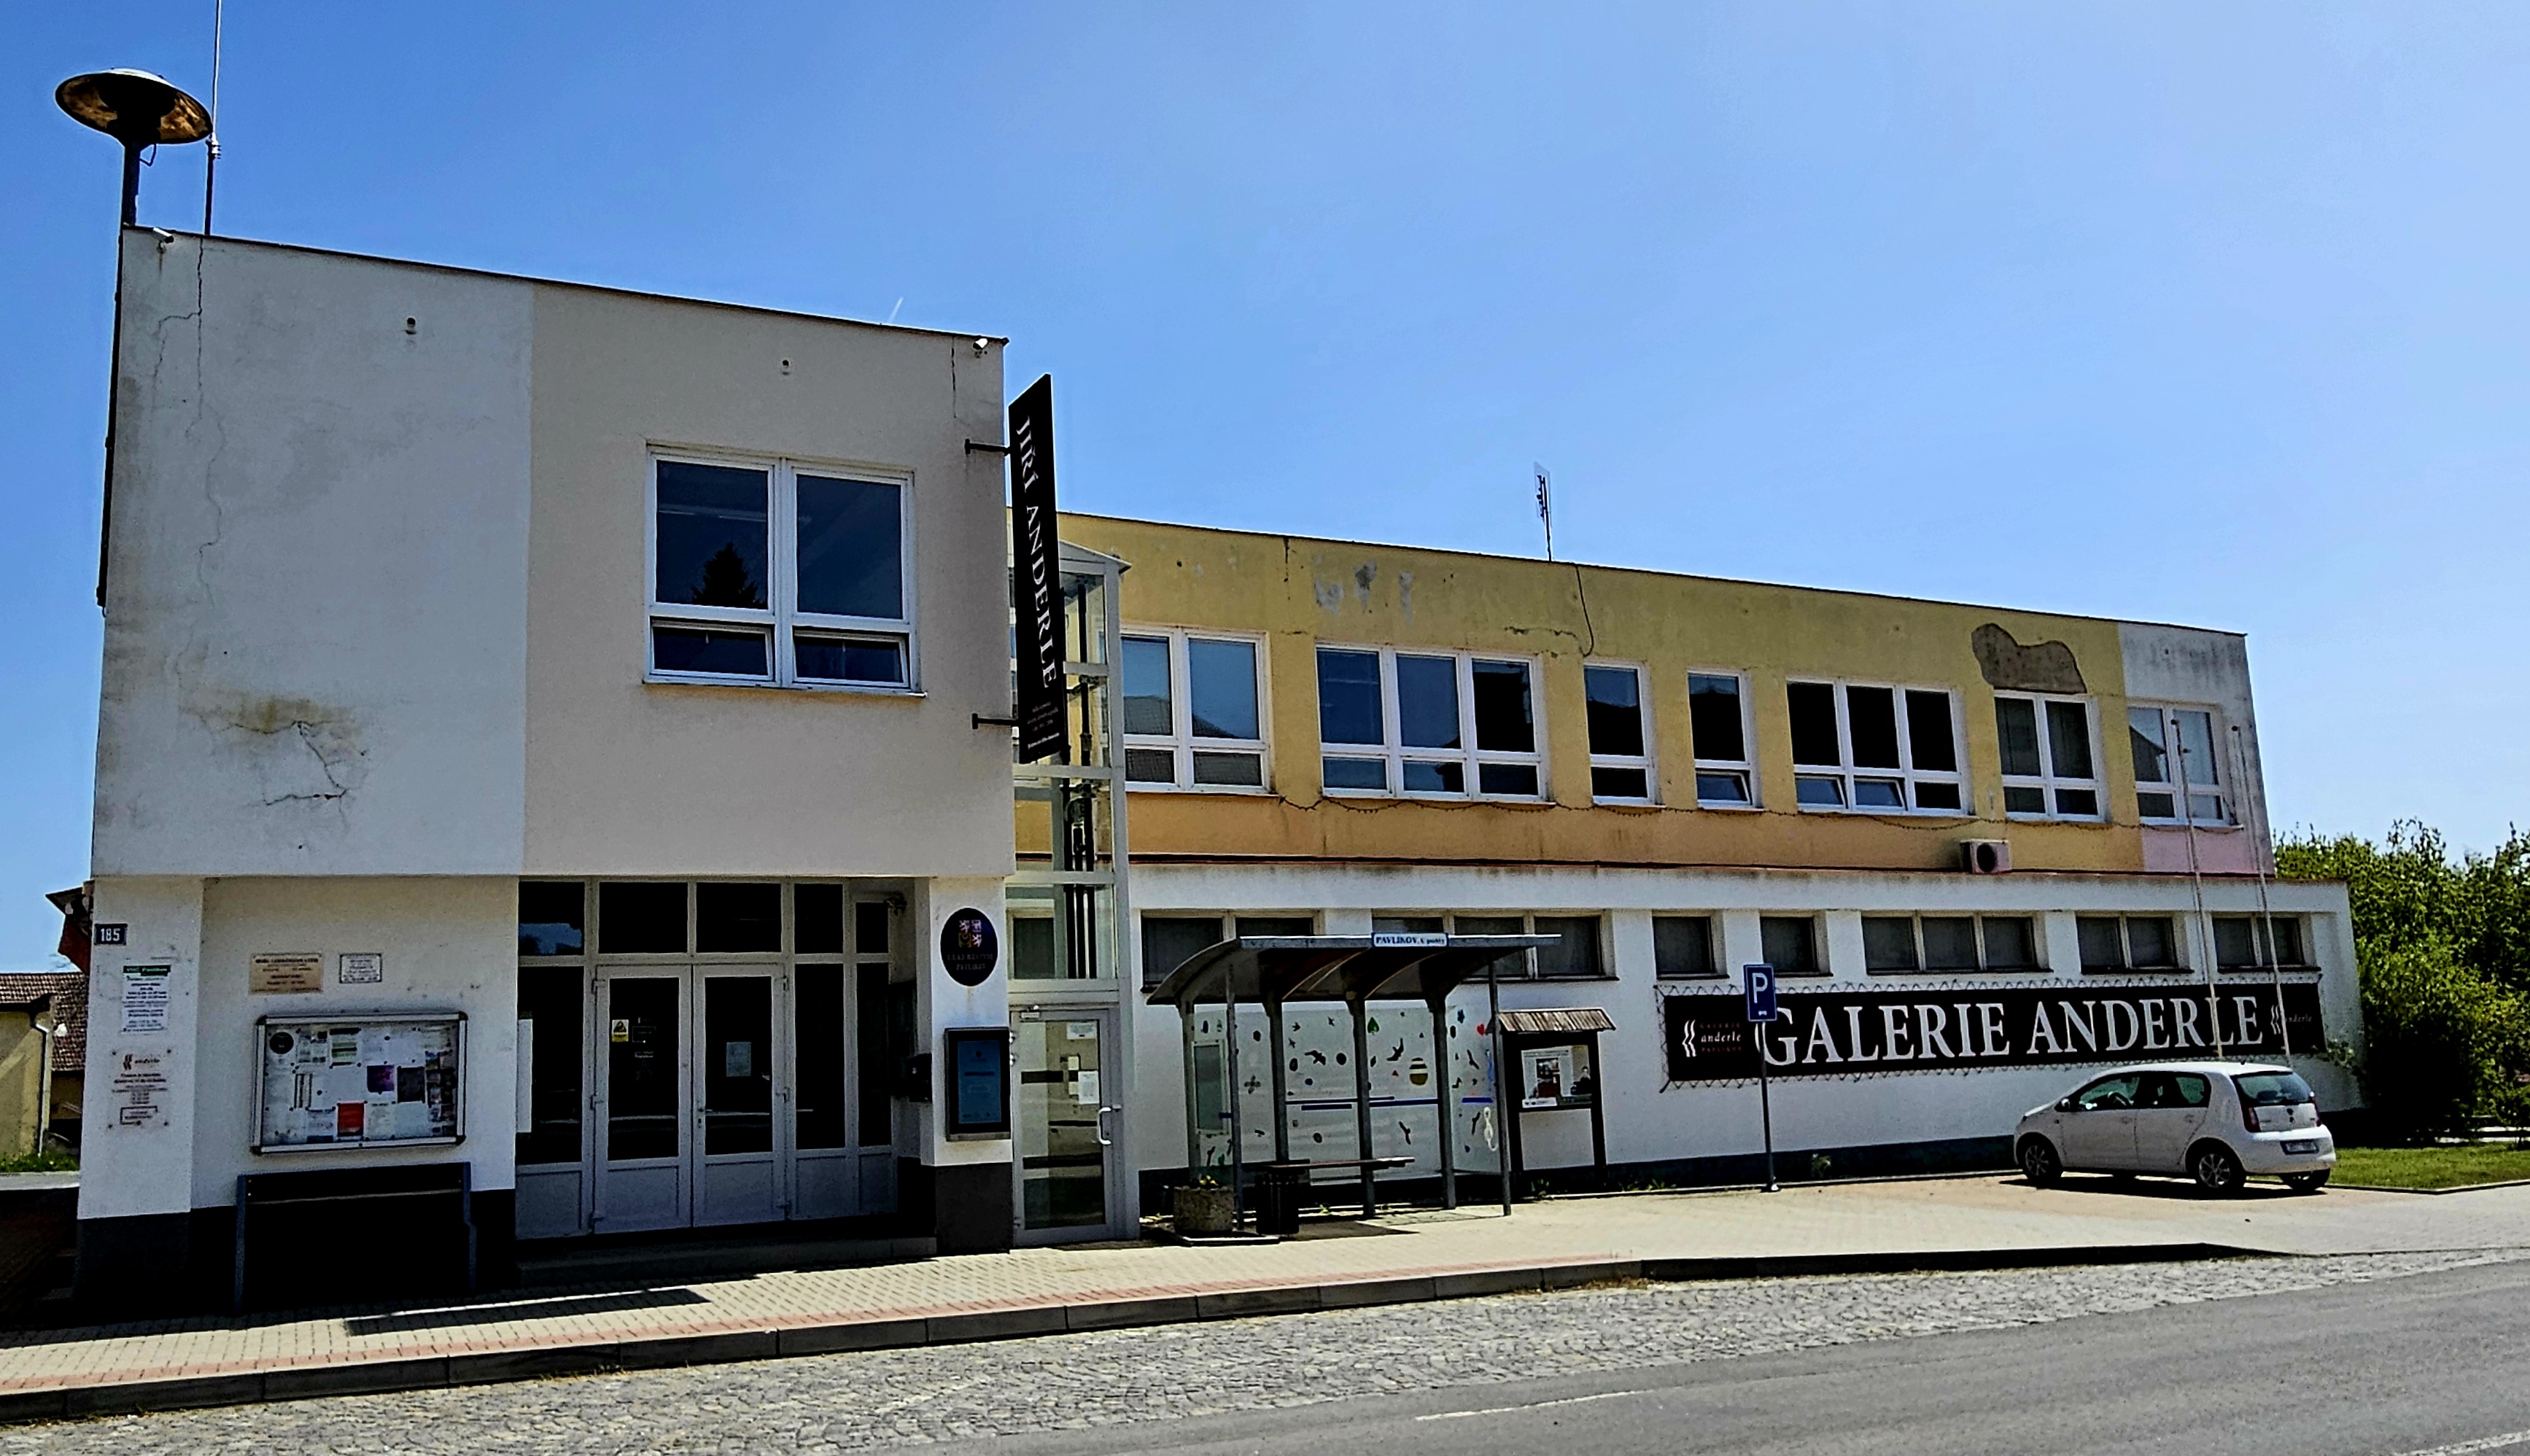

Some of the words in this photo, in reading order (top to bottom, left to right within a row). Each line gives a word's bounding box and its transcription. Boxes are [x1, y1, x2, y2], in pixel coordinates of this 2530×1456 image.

[1016, 415, 1039, 494] JIŘÍ
[1026, 505, 1057, 688] ANDERLE
[101, 928, 121, 942] 185
[1752, 972, 1768, 1004] P
[1701, 1031, 1742, 1043] anderle
[1755, 1002, 2011, 1066] GALERIE
[2027, 996, 2262, 1056] ANDERLE
